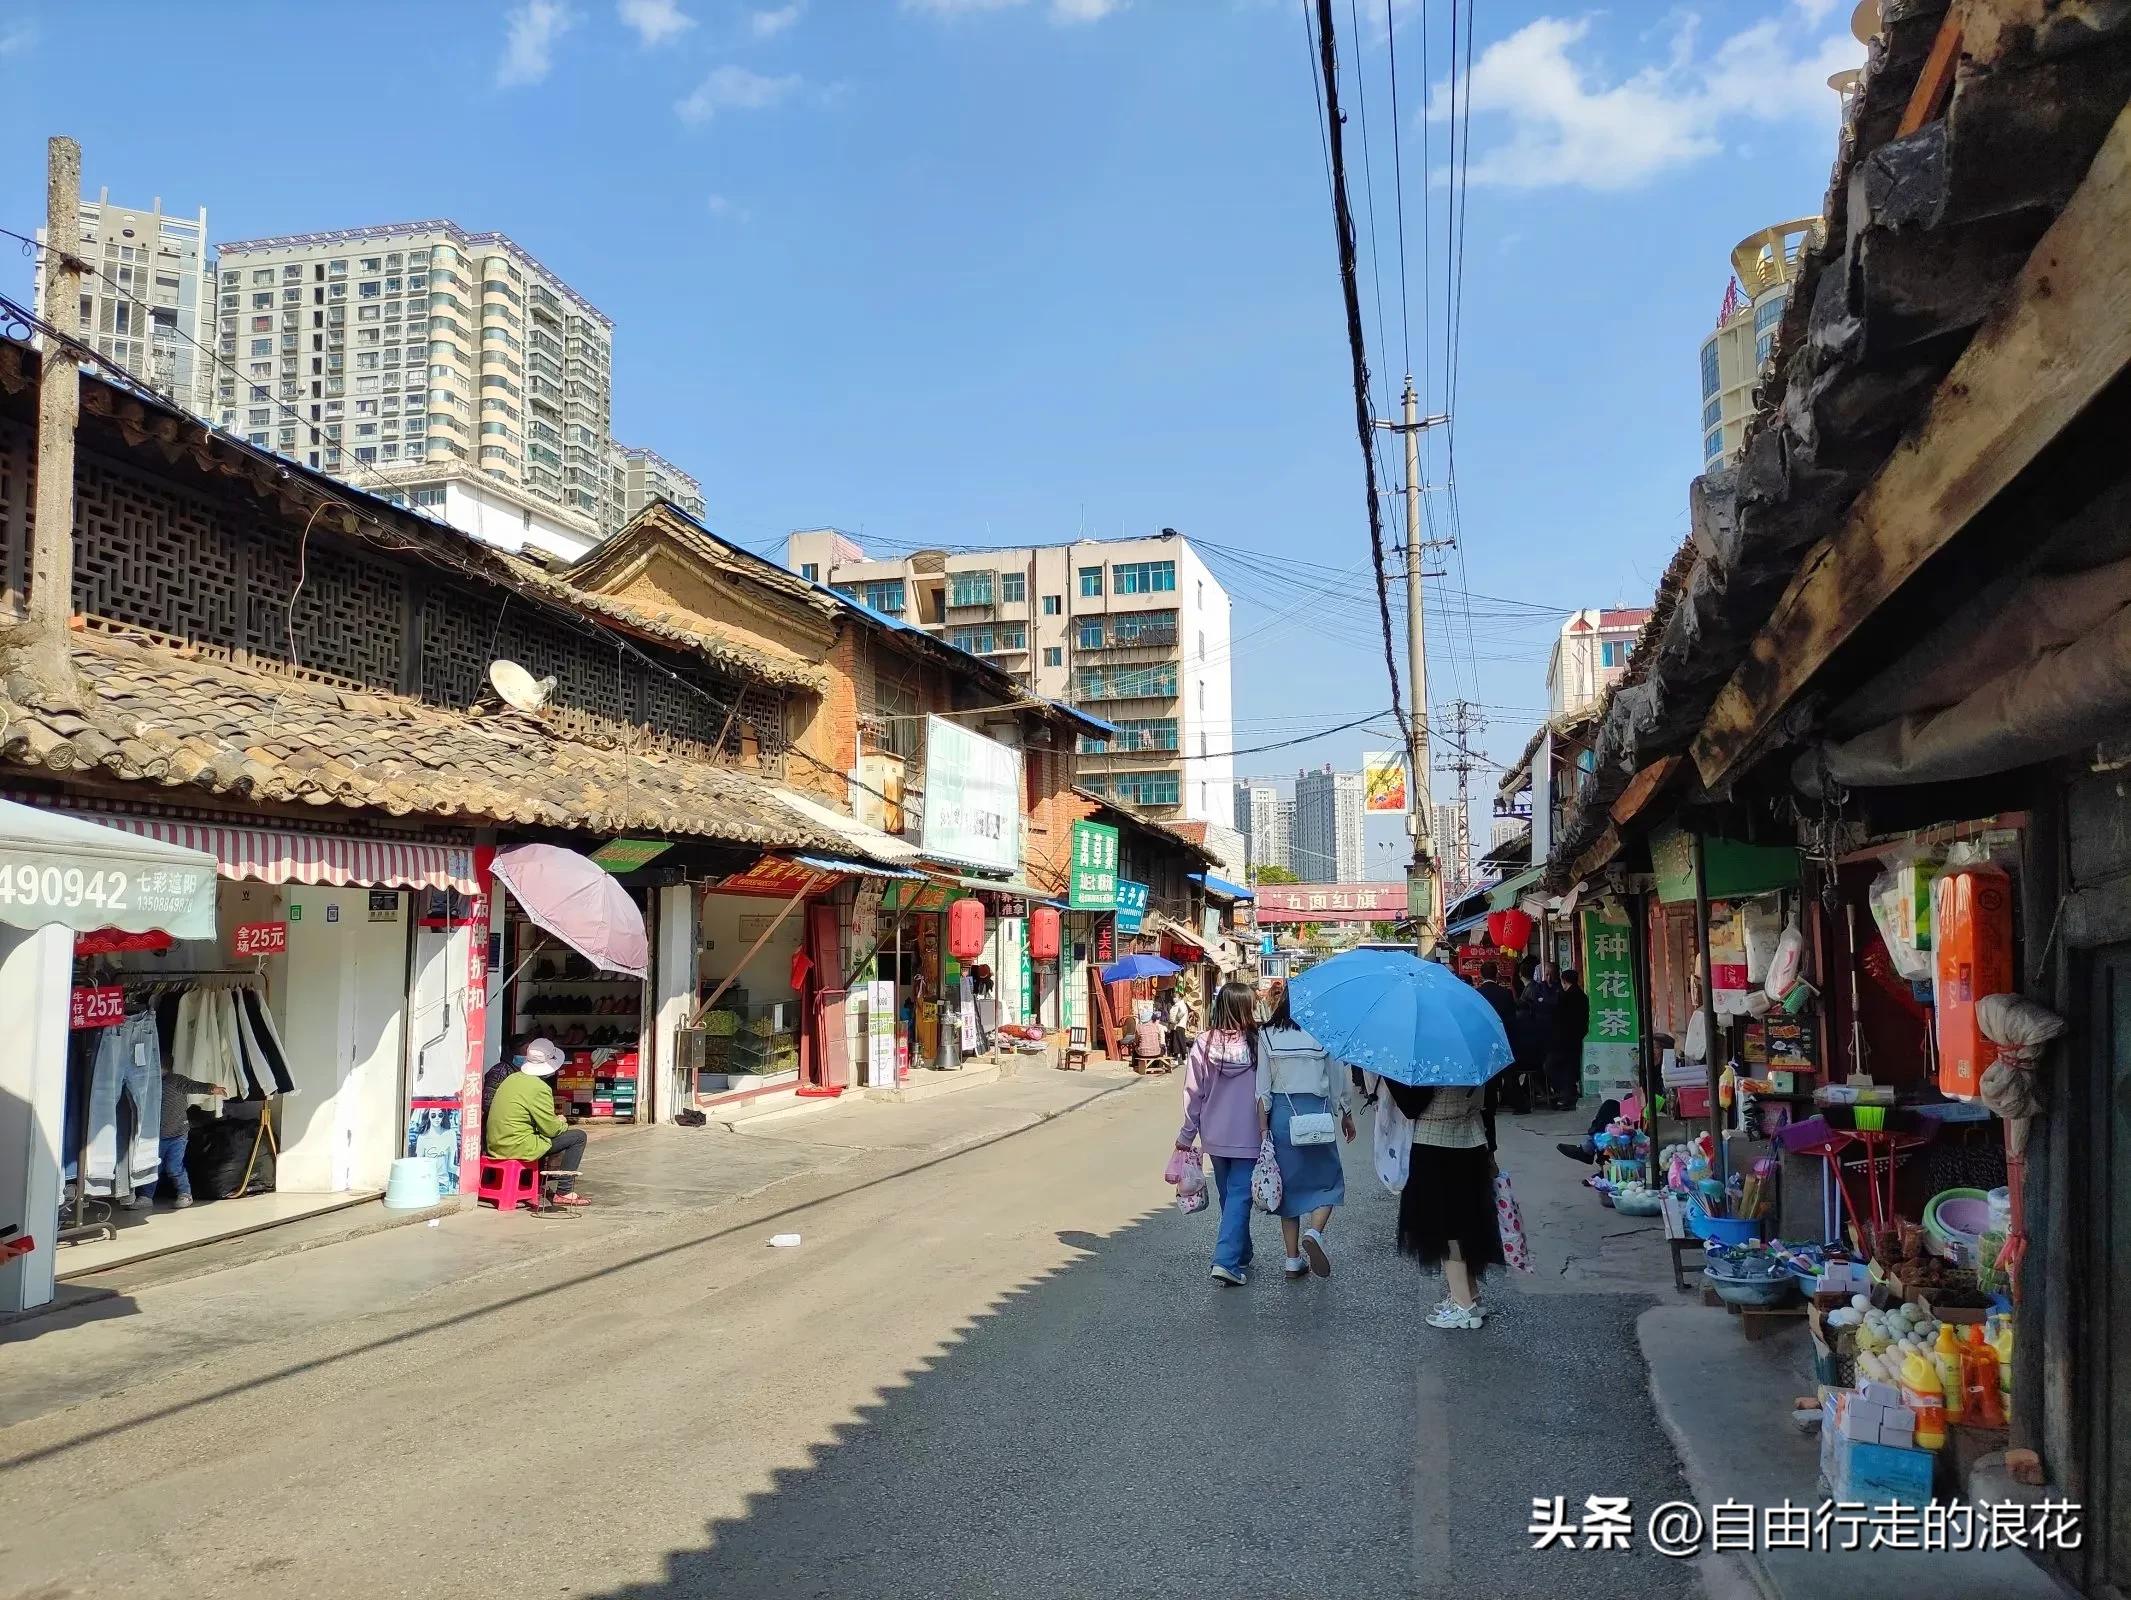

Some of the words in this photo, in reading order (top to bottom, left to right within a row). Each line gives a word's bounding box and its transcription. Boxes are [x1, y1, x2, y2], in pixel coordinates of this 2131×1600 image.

[1001, 903, 1025, 916] 推拿
[237, 926, 250, 953] 全场
[250, 926, 285, 948] 25元
[467, 892, 488, 1009] 品牌折扣
[1097, 919, 1113, 960] 三七天麻
[72, 992, 85, 1026] 牛仔裤
[86, 993, 123, 1017] 25元
[463, 1040, 483, 1162] 厂家直销
